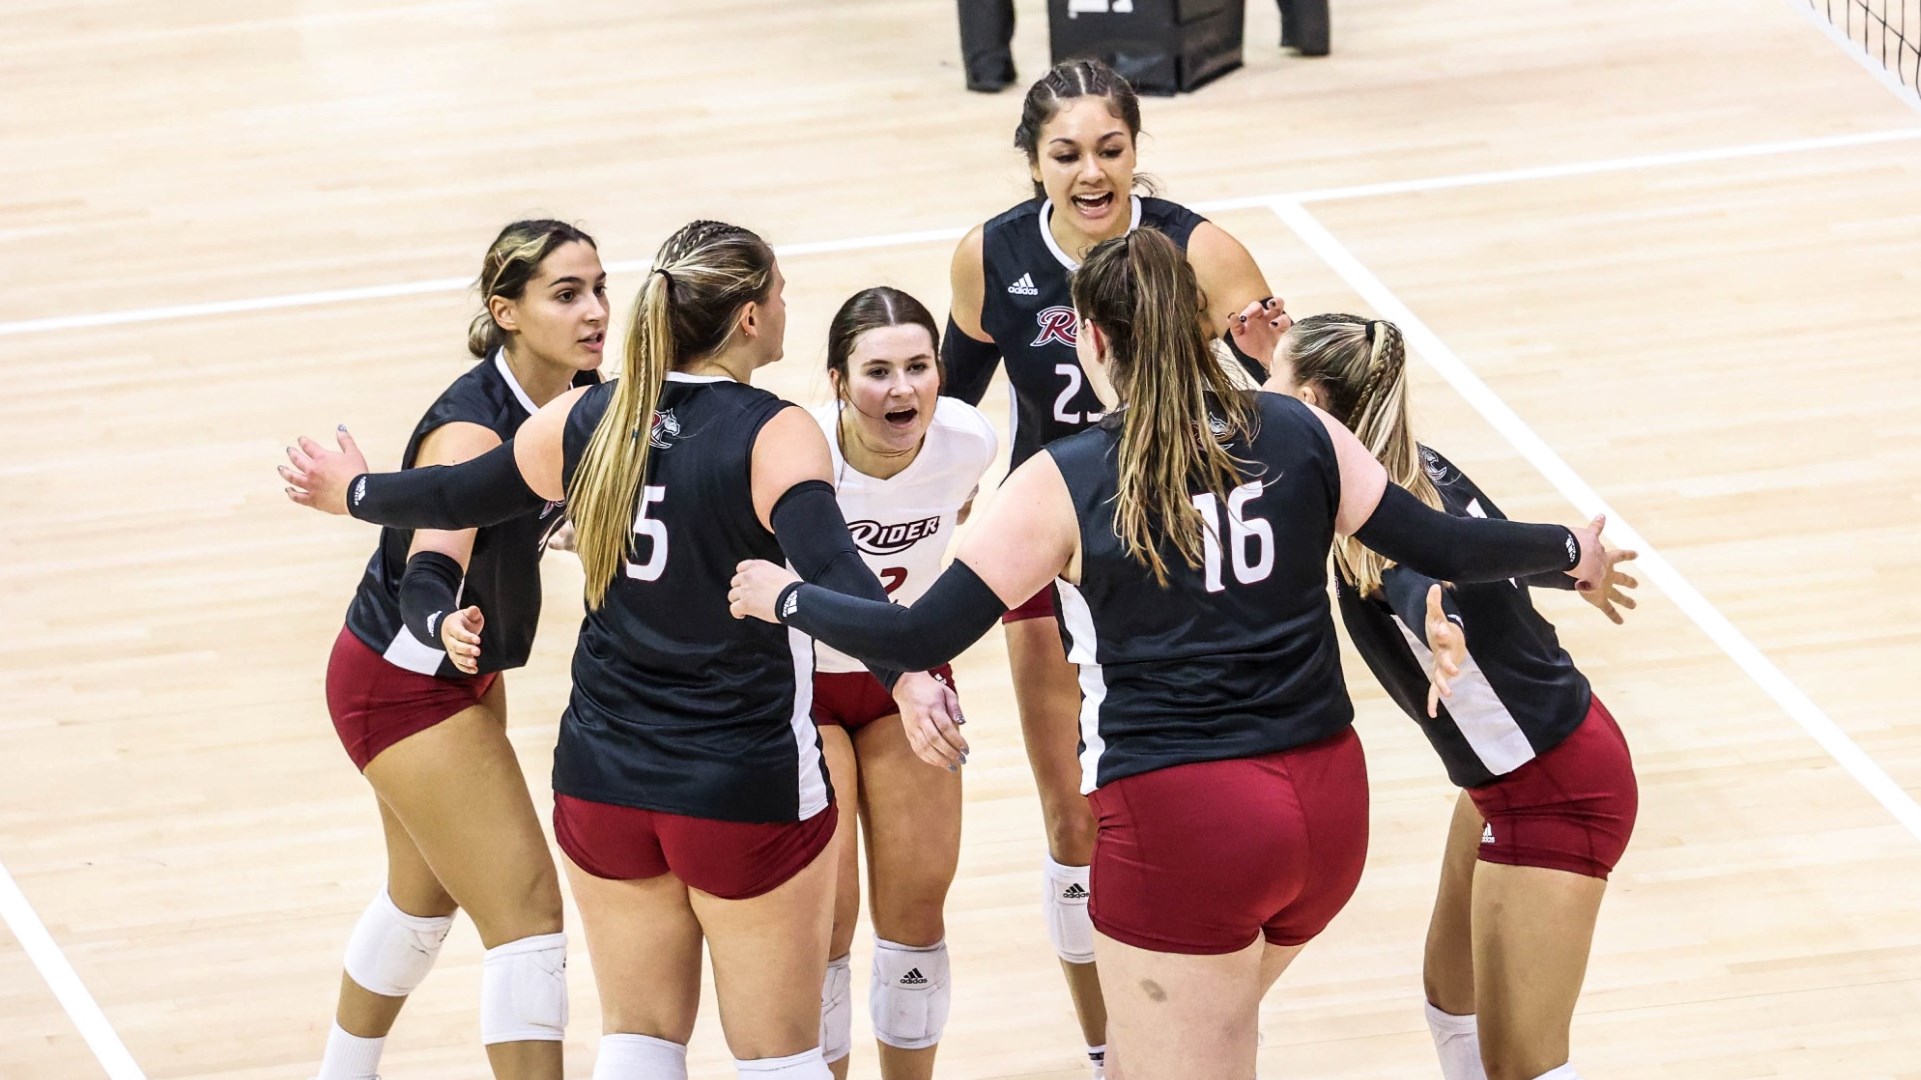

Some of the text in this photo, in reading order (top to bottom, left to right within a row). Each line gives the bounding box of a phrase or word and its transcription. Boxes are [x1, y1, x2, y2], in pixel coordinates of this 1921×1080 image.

[1008, 286, 1039, 295] adidas
[1053, 363, 1106, 424] 2
[626, 485, 668, 581] 5
[845, 515, 940, 555] RIDER
[1192, 480, 1275, 593] 16
[899, 977, 928, 985] adidas
